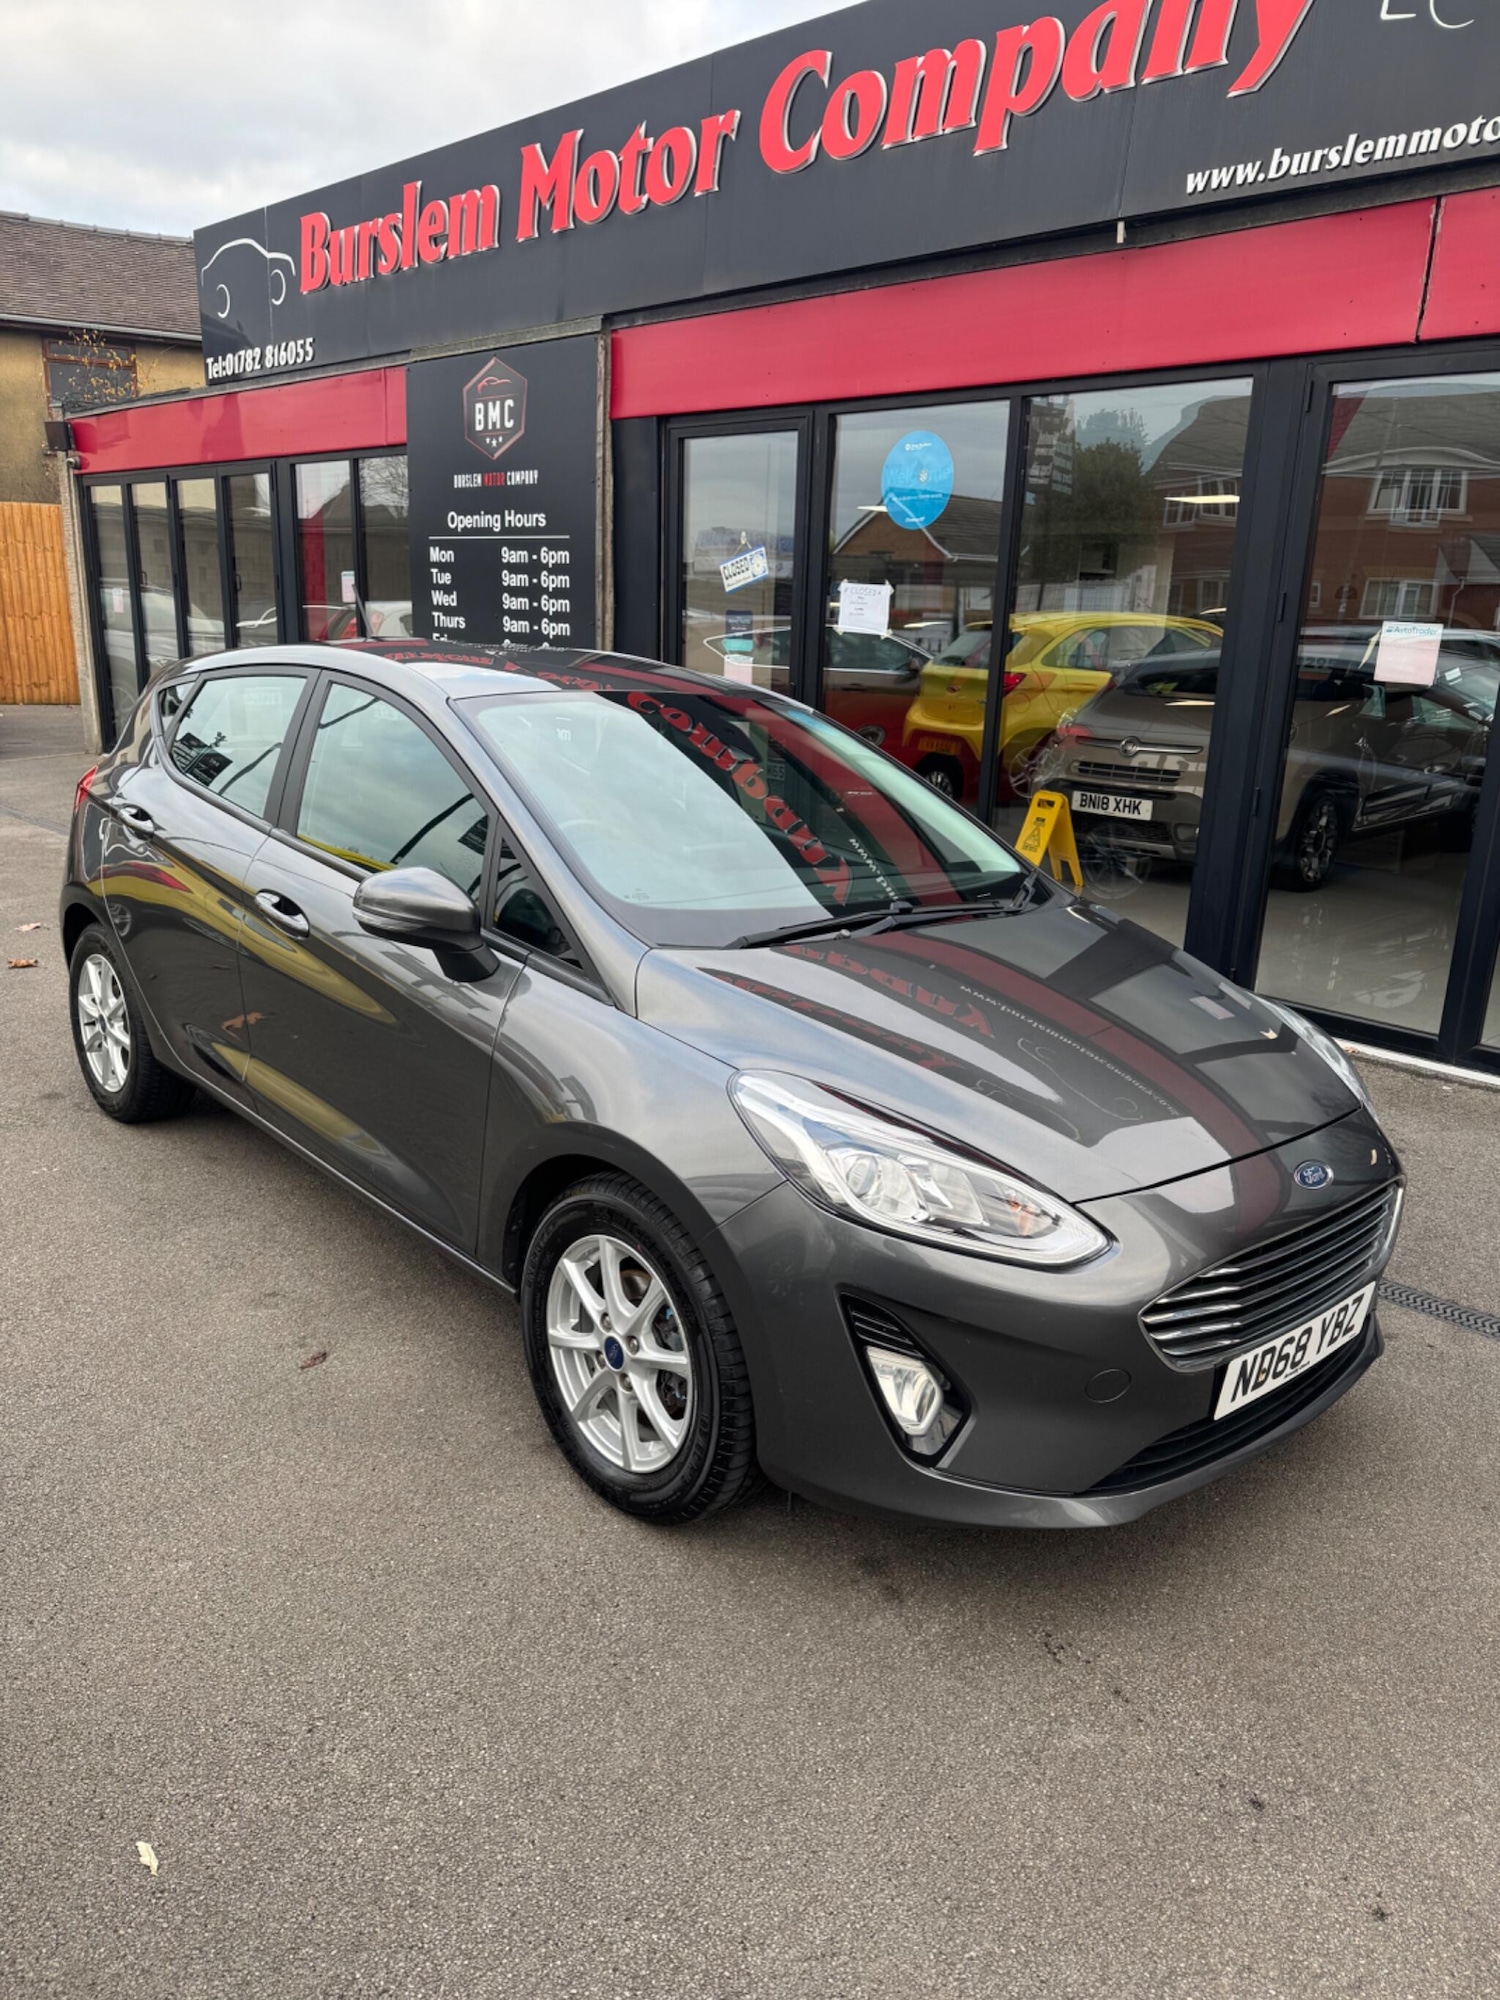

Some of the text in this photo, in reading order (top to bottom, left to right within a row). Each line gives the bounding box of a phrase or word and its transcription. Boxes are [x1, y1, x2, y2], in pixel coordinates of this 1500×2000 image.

[299, 0, 1312, 295] Burslem Motor Company
[205, 337, 315, 380] Tel:01782 816055
[474, 398, 515, 432] BMC
[453, 469, 539, 489] BURSLEM MOTOR COMPANY
[447, 509, 547, 532] Opening Hours
[429, 546, 455, 564] Mon
[500, 546, 529, 564] 9am
[540, 546, 570, 568] 6pm
[722, 556, 750, 581] CLOSED
[430, 568, 452, 585] Tue
[501, 569, 529, 587] 9am
[540, 571, 570, 592] 6pm
[431, 590, 458, 607] Wed
[502, 592, 530, 610] 9am
[541, 594, 570, 615] 6pm
[432, 611, 466, 629] Thurs
[502, 615, 530, 634] 9am
[541, 617, 571, 638] 6pm
[1078, 791, 1143, 816] BN18 XHK
[1230, 1292, 1366, 1403] ND68 YBZ
